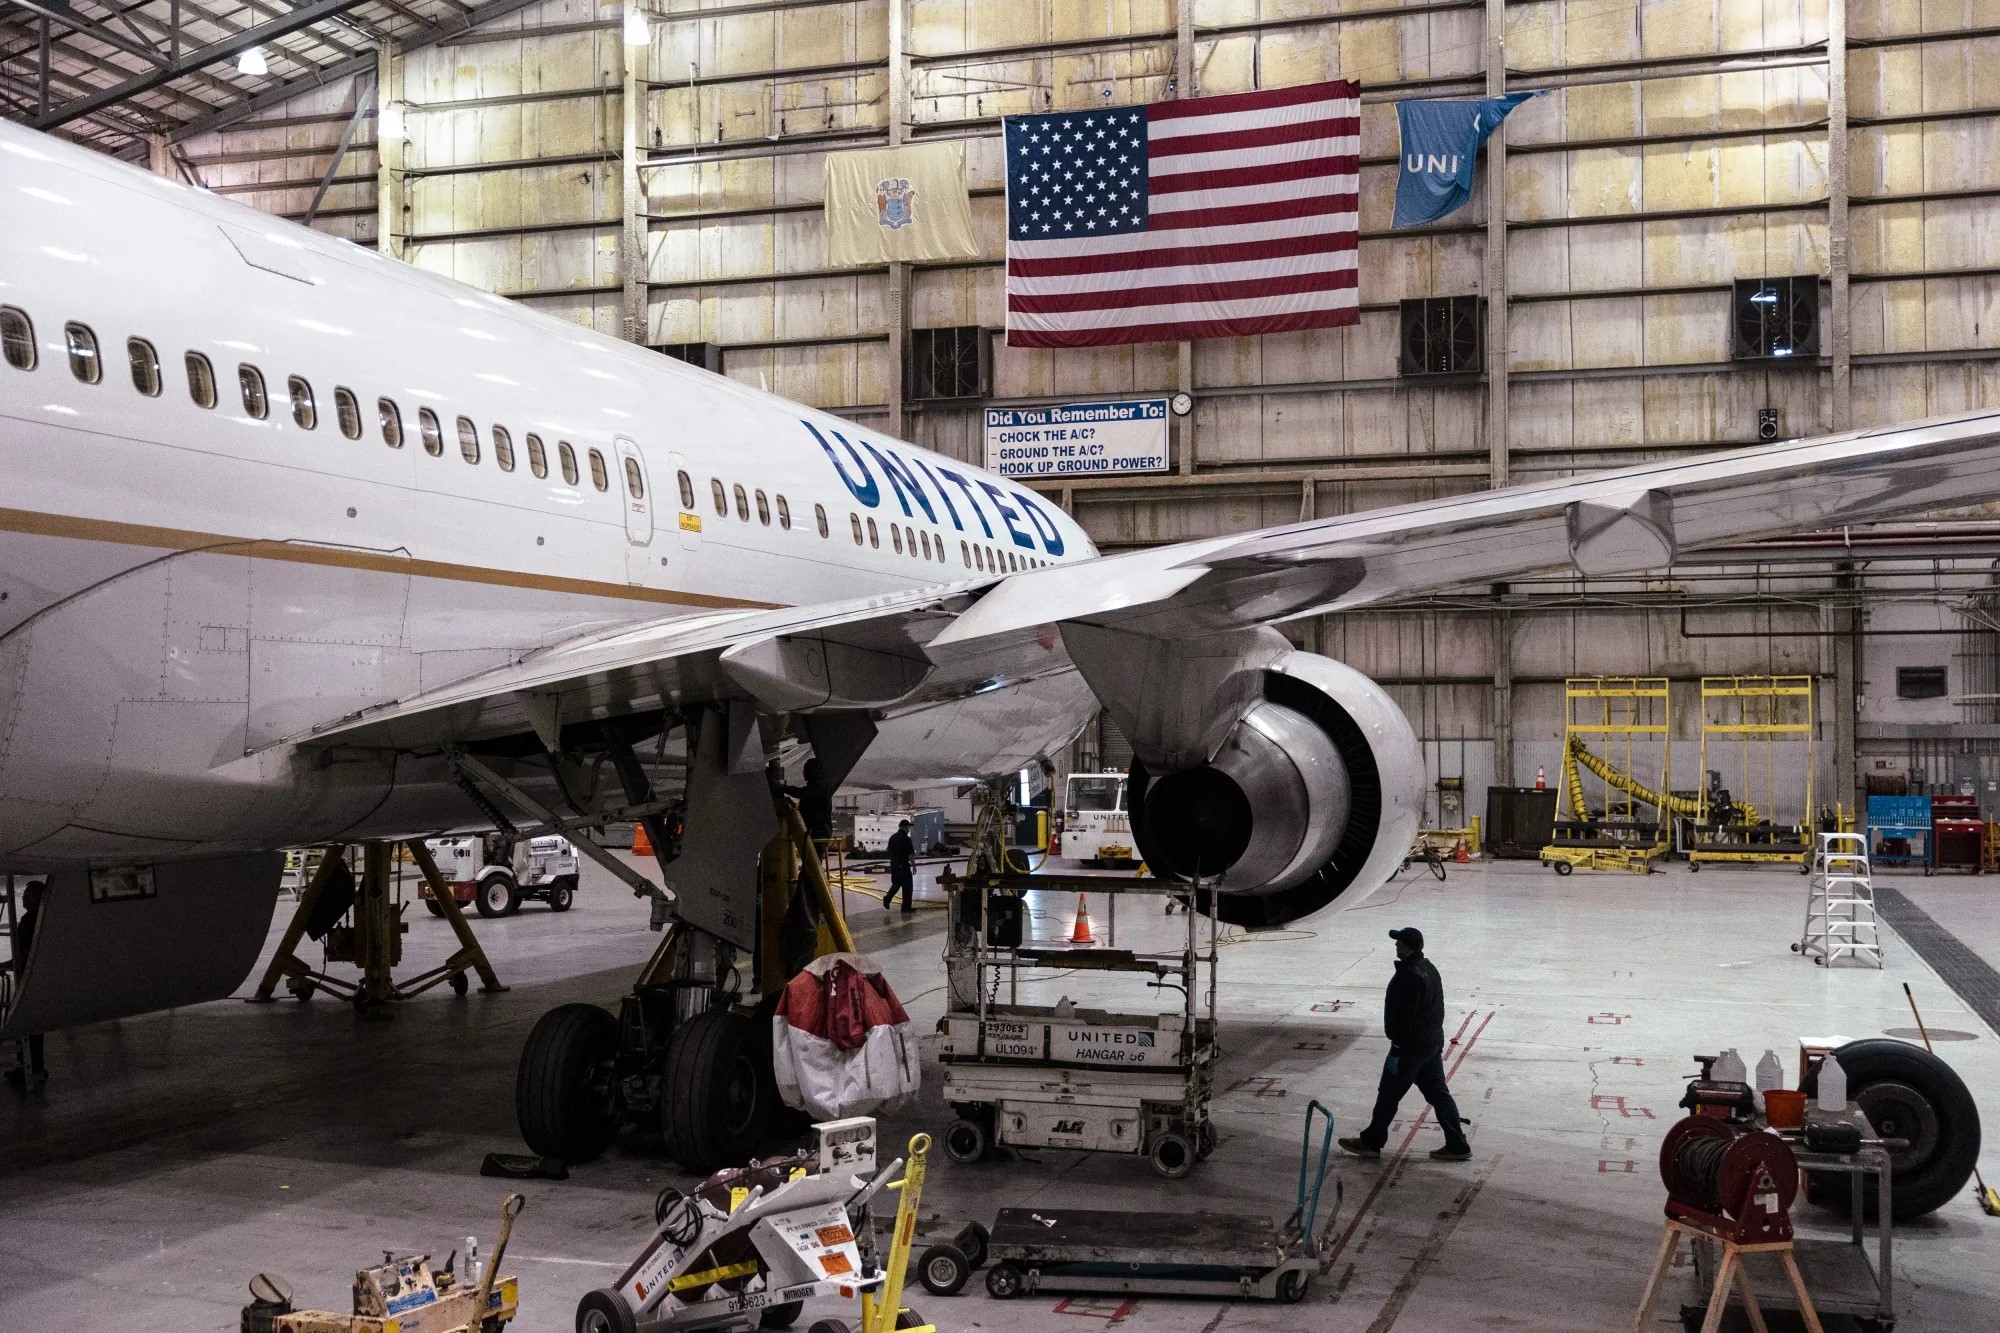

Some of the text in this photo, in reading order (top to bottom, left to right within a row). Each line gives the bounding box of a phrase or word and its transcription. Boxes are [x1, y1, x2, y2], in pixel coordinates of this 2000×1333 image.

[988, 403, 1164, 426] Did You Remember To:
[999, 428, 1096, 443] CHOCK THE A/C?
[1000, 444, 1104, 460] GROUND THE A/C?
[999, 456, 1163, 474] HOOK UP GROUND POWER?
[800, 419, 1065, 557] UNITED
[1068, 1031, 1137, 1044] UNITED
[1076, 1048, 1125, 1060] HANGAR
[1051, 1119, 1086, 1134] JLG
[783, 1286, 815, 1300] NITROGEN
